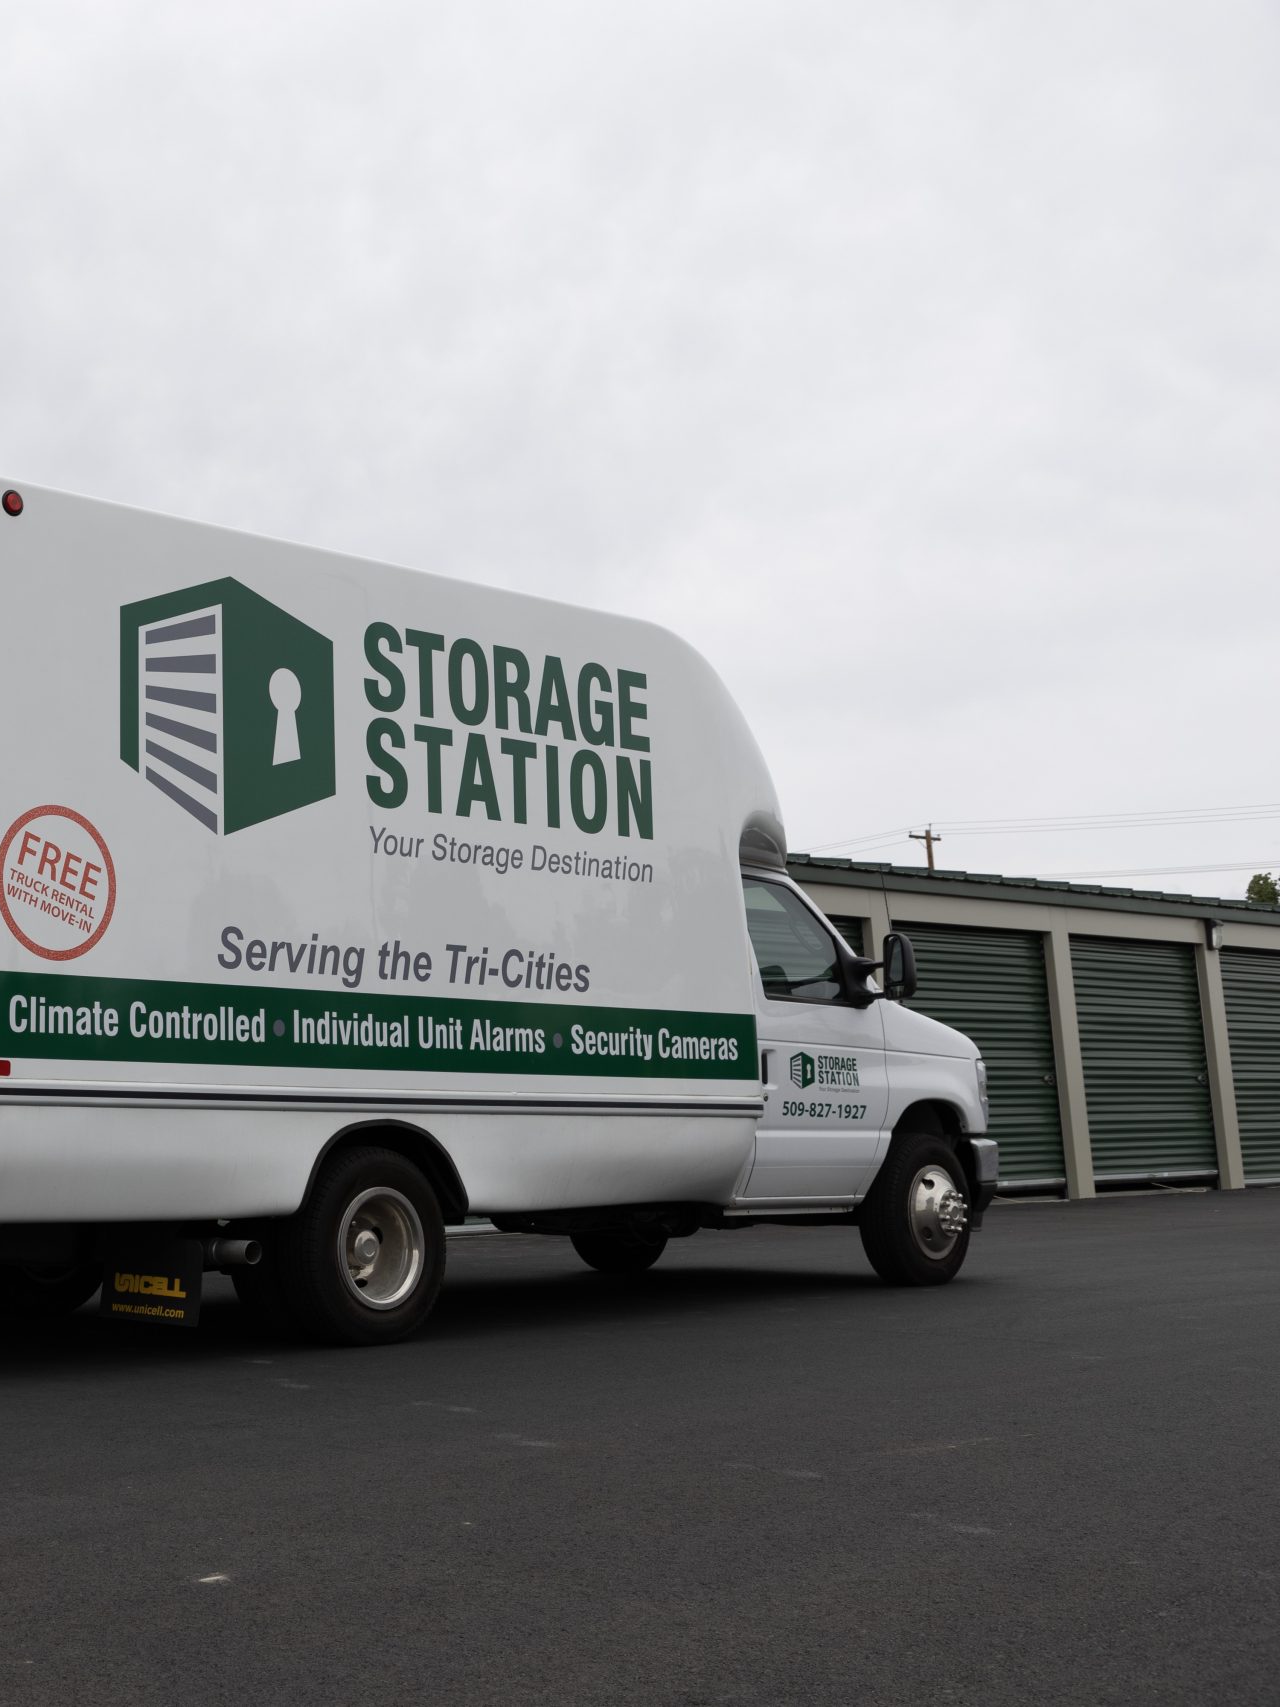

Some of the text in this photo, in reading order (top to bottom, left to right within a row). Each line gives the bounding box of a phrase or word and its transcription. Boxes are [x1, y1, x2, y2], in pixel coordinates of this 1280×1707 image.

[363, 621, 651, 753] STORAGE
[365, 717, 654, 840] STATION
[17, 830, 103, 901] FREE
[369, 825, 654, 883] Your Storage Destination
[7, 883, 93, 934] WITH MOVE-IN
[10, 867, 95, 919] TRUCK RENTAL
[217, 925, 591, 993] Serving the Tri-Cities
[8, 994, 739, 1061] Climate Controlled Individual Unit Alarms Security Cameras
[817, 1055, 858, 1073] STORAGE
[818, 1070, 860, 1087] STATION
[782, 1100, 867, 1120] 509-827-1927
[111, 1303, 185, 1319] www.unicell.com
[114, 1272, 187, 1299] UNICELL
